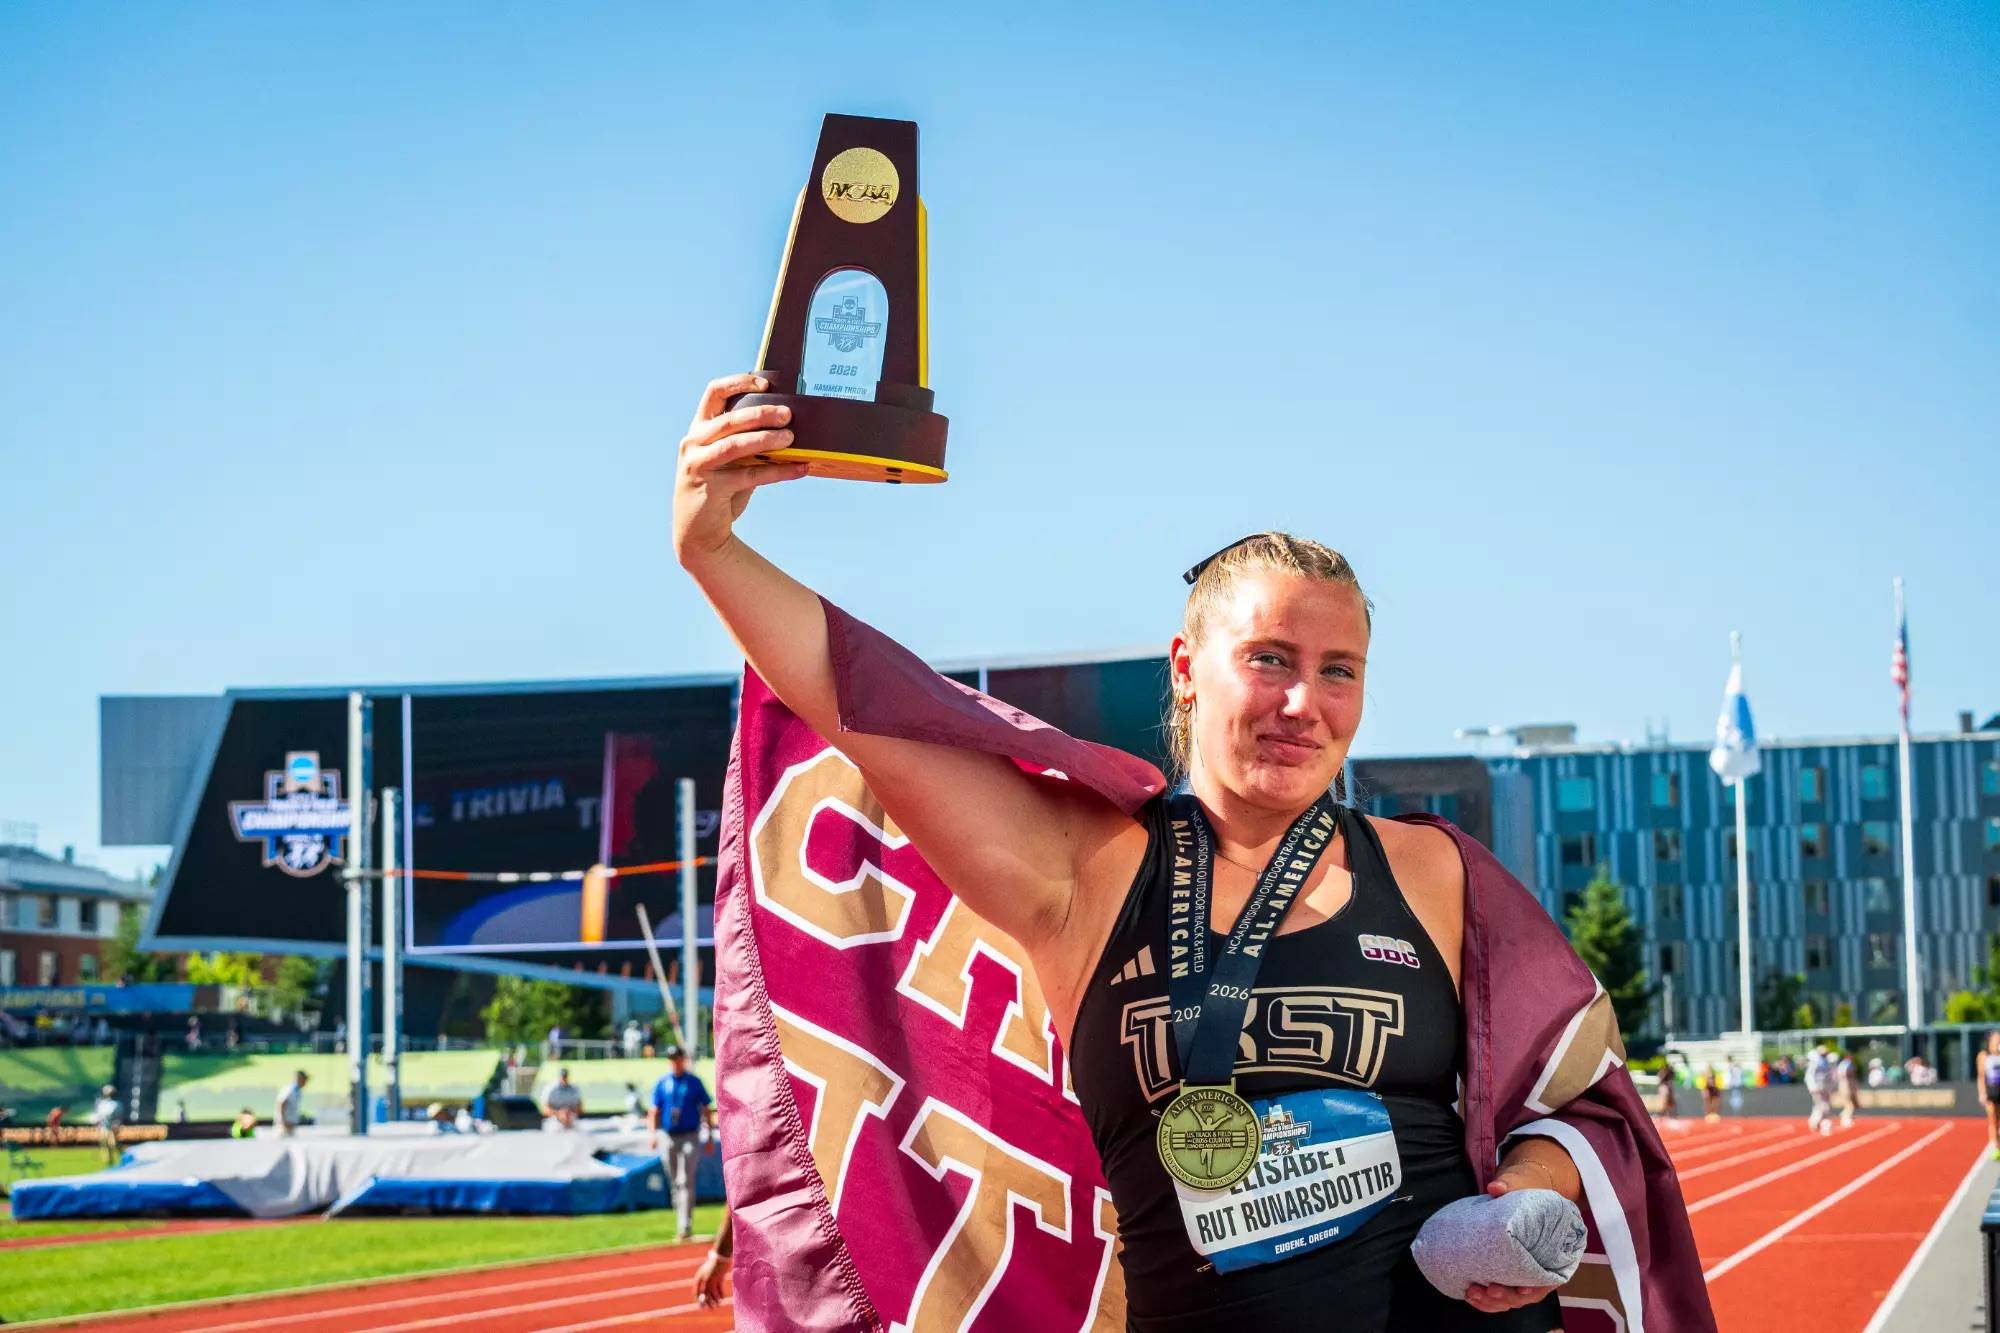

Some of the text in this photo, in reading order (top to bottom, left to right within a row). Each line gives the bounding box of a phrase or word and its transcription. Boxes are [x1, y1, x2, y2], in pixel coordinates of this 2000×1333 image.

[827, 182, 891, 201] NCAA
[819, 321, 876, 334] CHAMPIONSHIPS
[829, 364, 858, 377] 2026
[813, 383, 868, 395] HAMMER THROW
[451, 778, 566, 821] TRIVIA
[1294, 822, 1305, 834] &
[1297, 805, 1318, 828] FIELD
[1279, 831, 1301, 857] TRACK
[1242, 811, 1335, 957] ALL-AMERICAN
[1260, 854, 1289, 894] OUTDOOR
[1171, 820, 1193, 979] ALL-AMERICAN
[1195, 870, 1208, 910] OUTDOOR
[1194, 911, 1205, 940] TRACK
[1239, 896, 1266, 930] DIVISION
[1226, 927, 1247, 955] NCAA
[1358, 934, 1420, 969] SBC
[1193, 947, 1205, 973] FIELD
[1209, 984, 1249, 1001] 2026
[1174, 1005, 1202, 1024] 202
[1120, 986, 1404, 1104] TST
[1170, 1090, 1247, 1119] ALL-AMERICAN
[1262, 1126, 1307, 1142] AMPIONSHIPS
[1196, 1161, 1395, 1245] RUT RUNARSDOTTIR
[1274, 1226, 1339, 1255] EUGENE, OREGON
